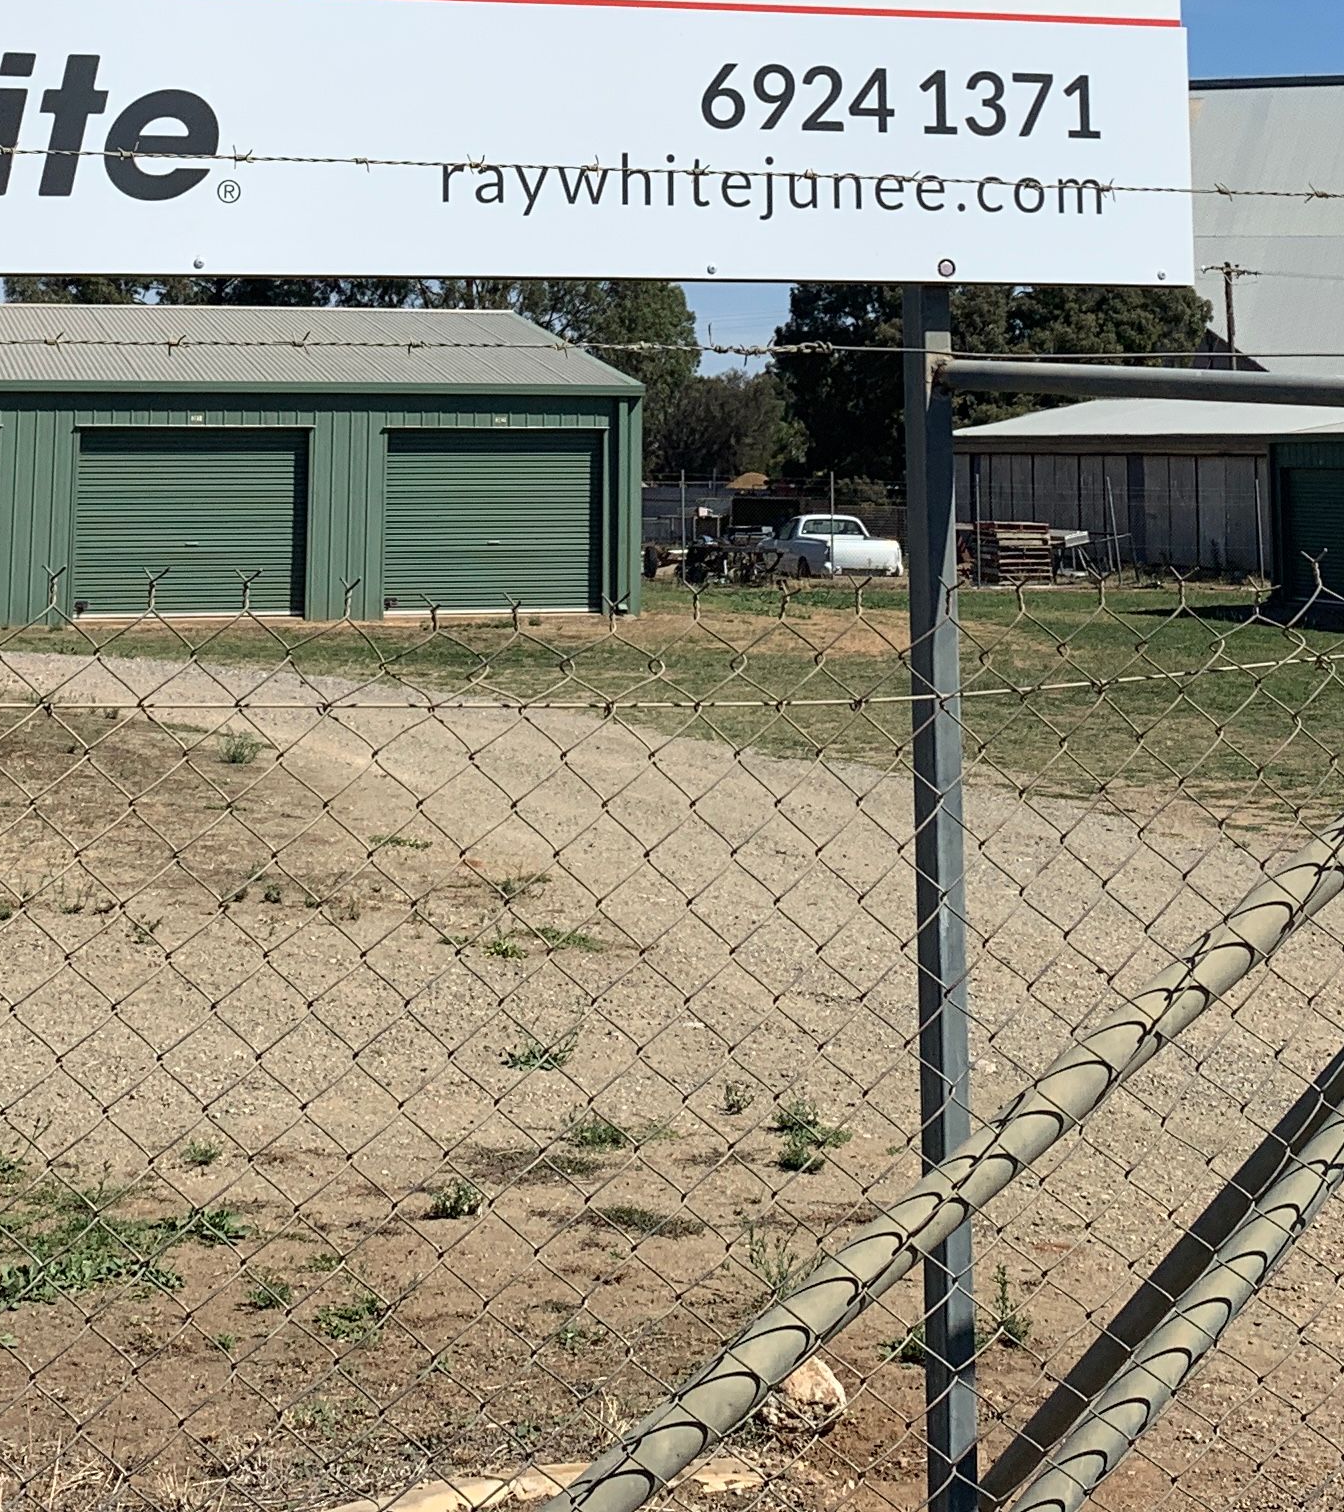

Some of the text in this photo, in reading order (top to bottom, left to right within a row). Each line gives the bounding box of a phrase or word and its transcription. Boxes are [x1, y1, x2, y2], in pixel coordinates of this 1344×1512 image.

[701, 62, 1102, 140] 6924 1371
[441, 152, 1106, 220] raywhitejunee.com
